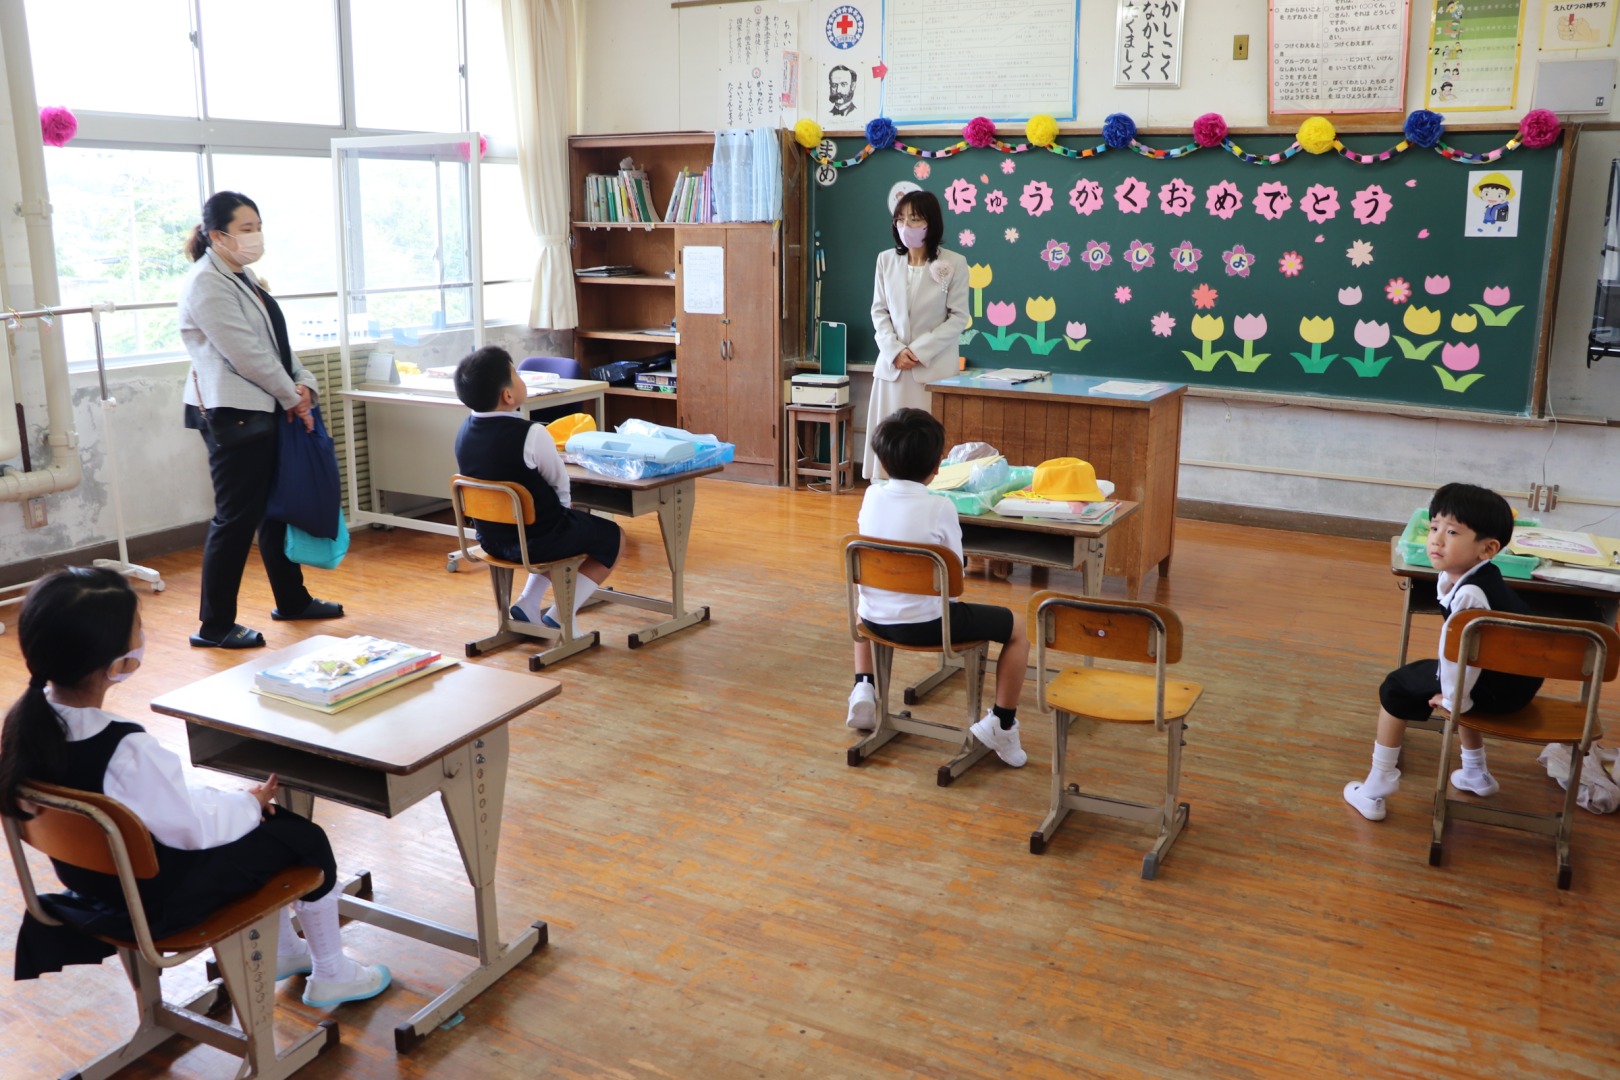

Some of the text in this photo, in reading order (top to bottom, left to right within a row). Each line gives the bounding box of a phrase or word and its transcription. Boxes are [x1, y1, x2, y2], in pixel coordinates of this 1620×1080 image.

[1553, 2, 1607, 11] えんぴつの持ち方
[783, 20, 792, 46] ちかい
[1141, 1, 1158, 80] なかよく
[1161, 1, 1178, 80] かしこく
[953, 179, 1383, 222] にゅうがくおめでとう
[1050, 248, 1247, 269] たのしいよ
